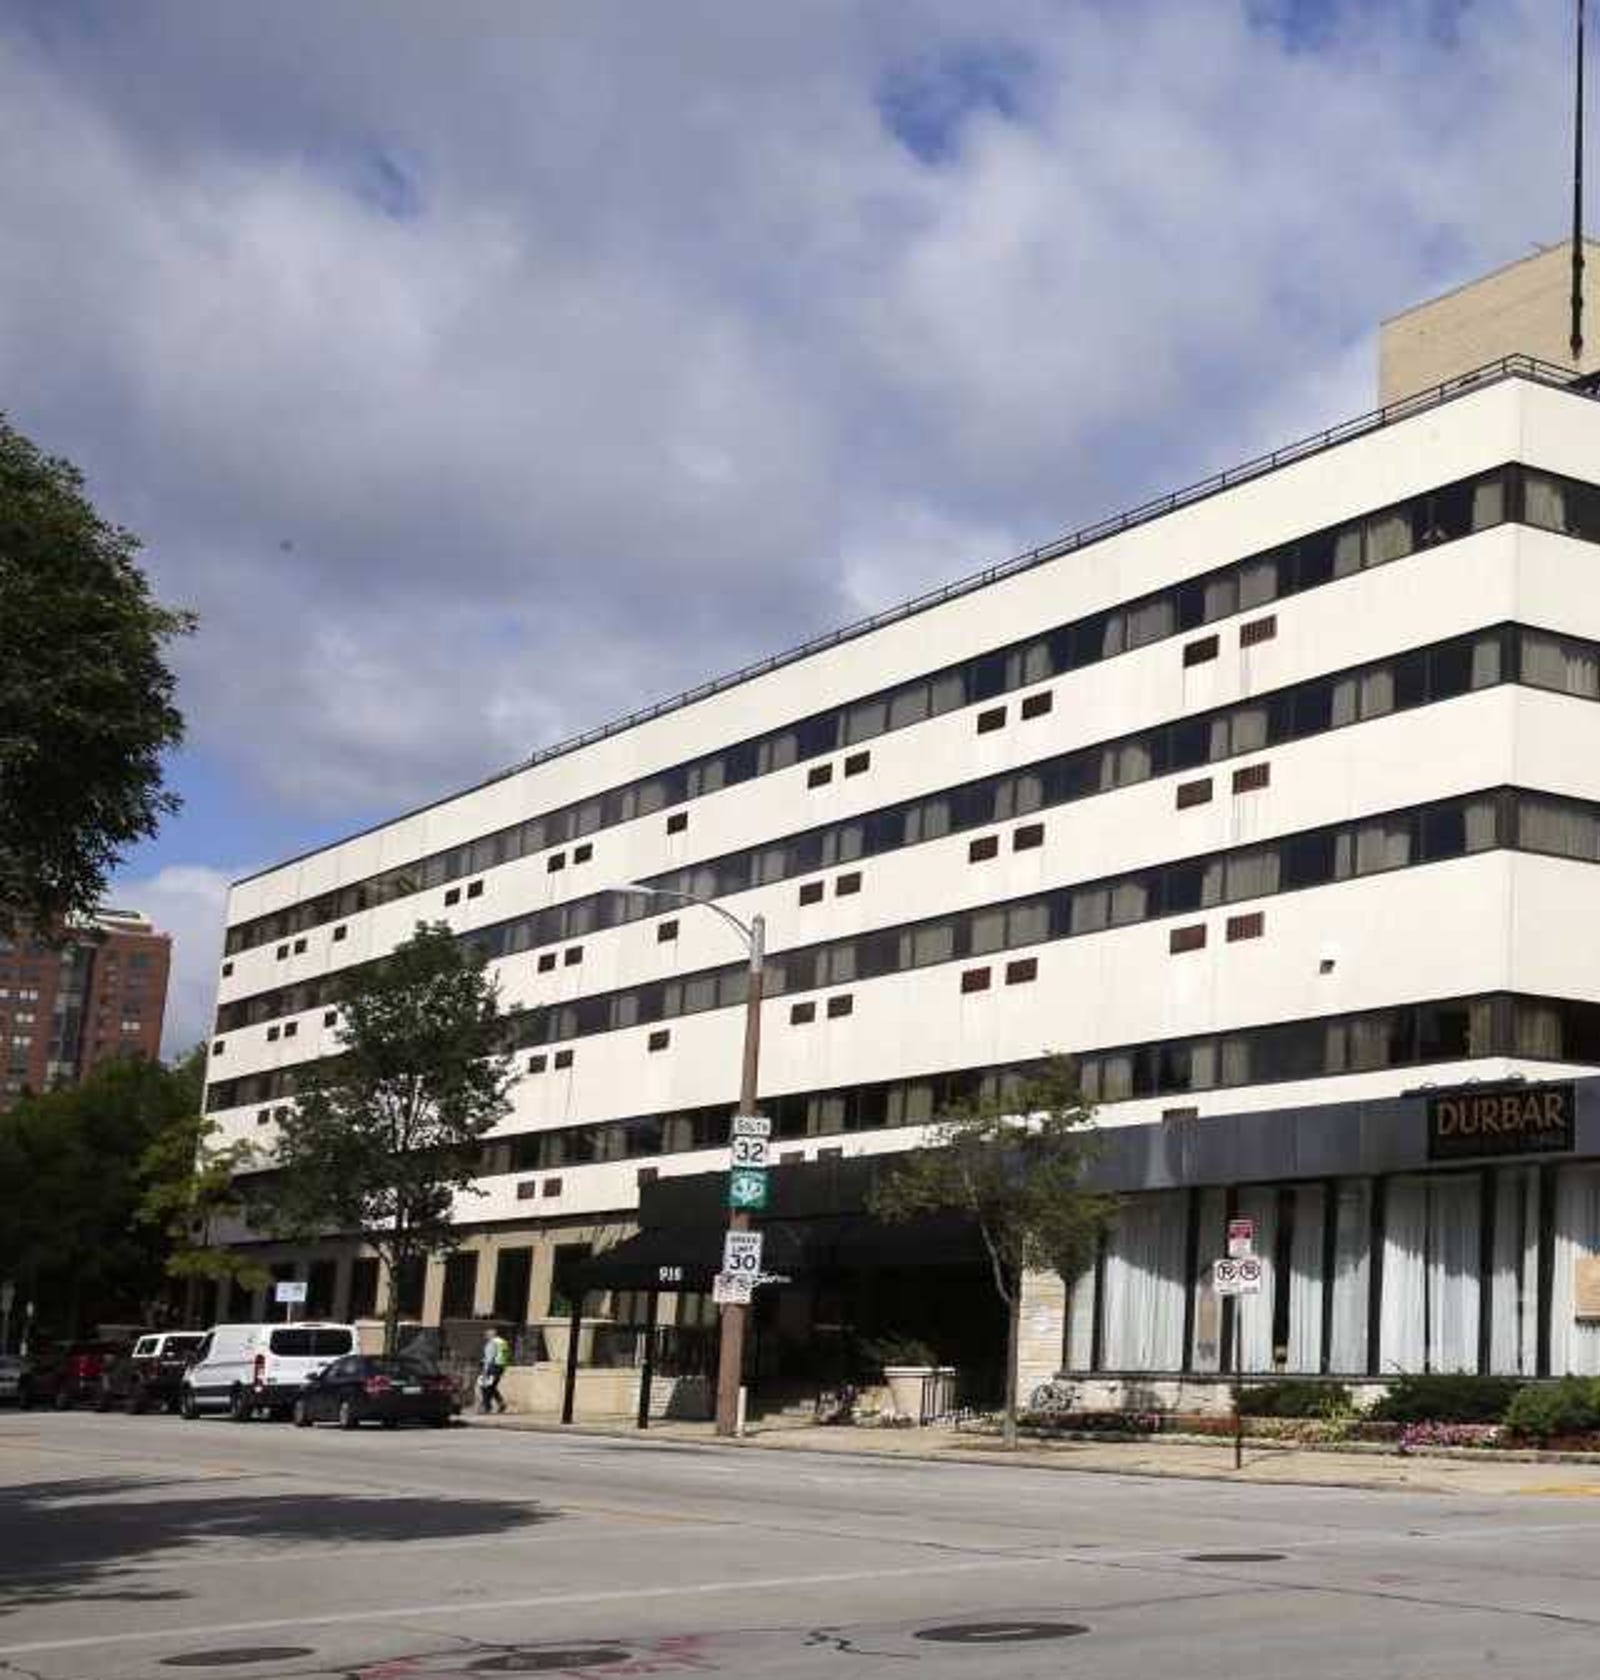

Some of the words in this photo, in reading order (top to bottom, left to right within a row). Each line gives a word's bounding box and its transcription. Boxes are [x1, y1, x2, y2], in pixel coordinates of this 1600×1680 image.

[1438, 1092, 1566, 1135] DURBAR
[736, 1142, 764, 1162] 32
[729, 1254, 756, 1271] 30
